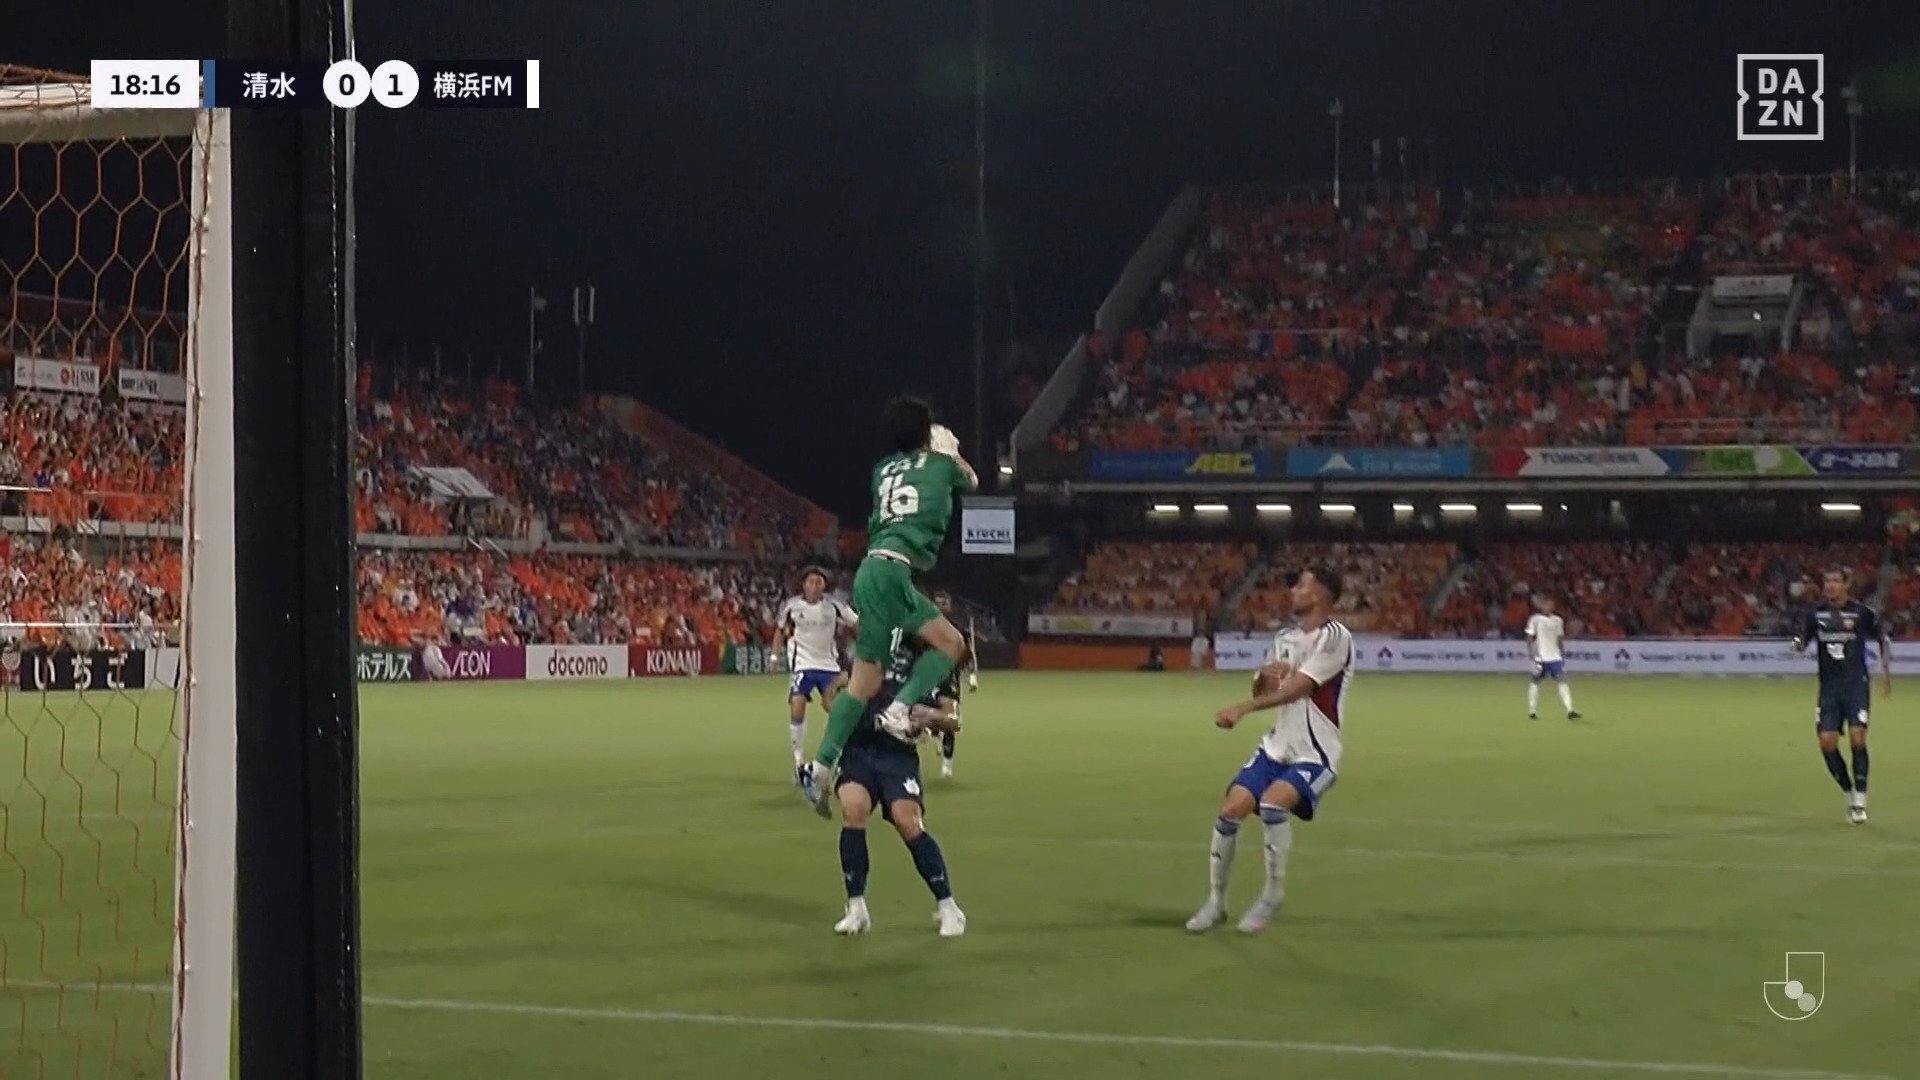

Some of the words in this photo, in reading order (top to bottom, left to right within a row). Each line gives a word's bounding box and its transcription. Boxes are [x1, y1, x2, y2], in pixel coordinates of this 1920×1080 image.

[878, 473, 919, 525] 16
[967, 528, 1010, 539] KIUCHI
[33, 652, 129, 690] いちご
[548, 649, 608, 676] docomo
[646, 649, 701, 674] KONAMI
